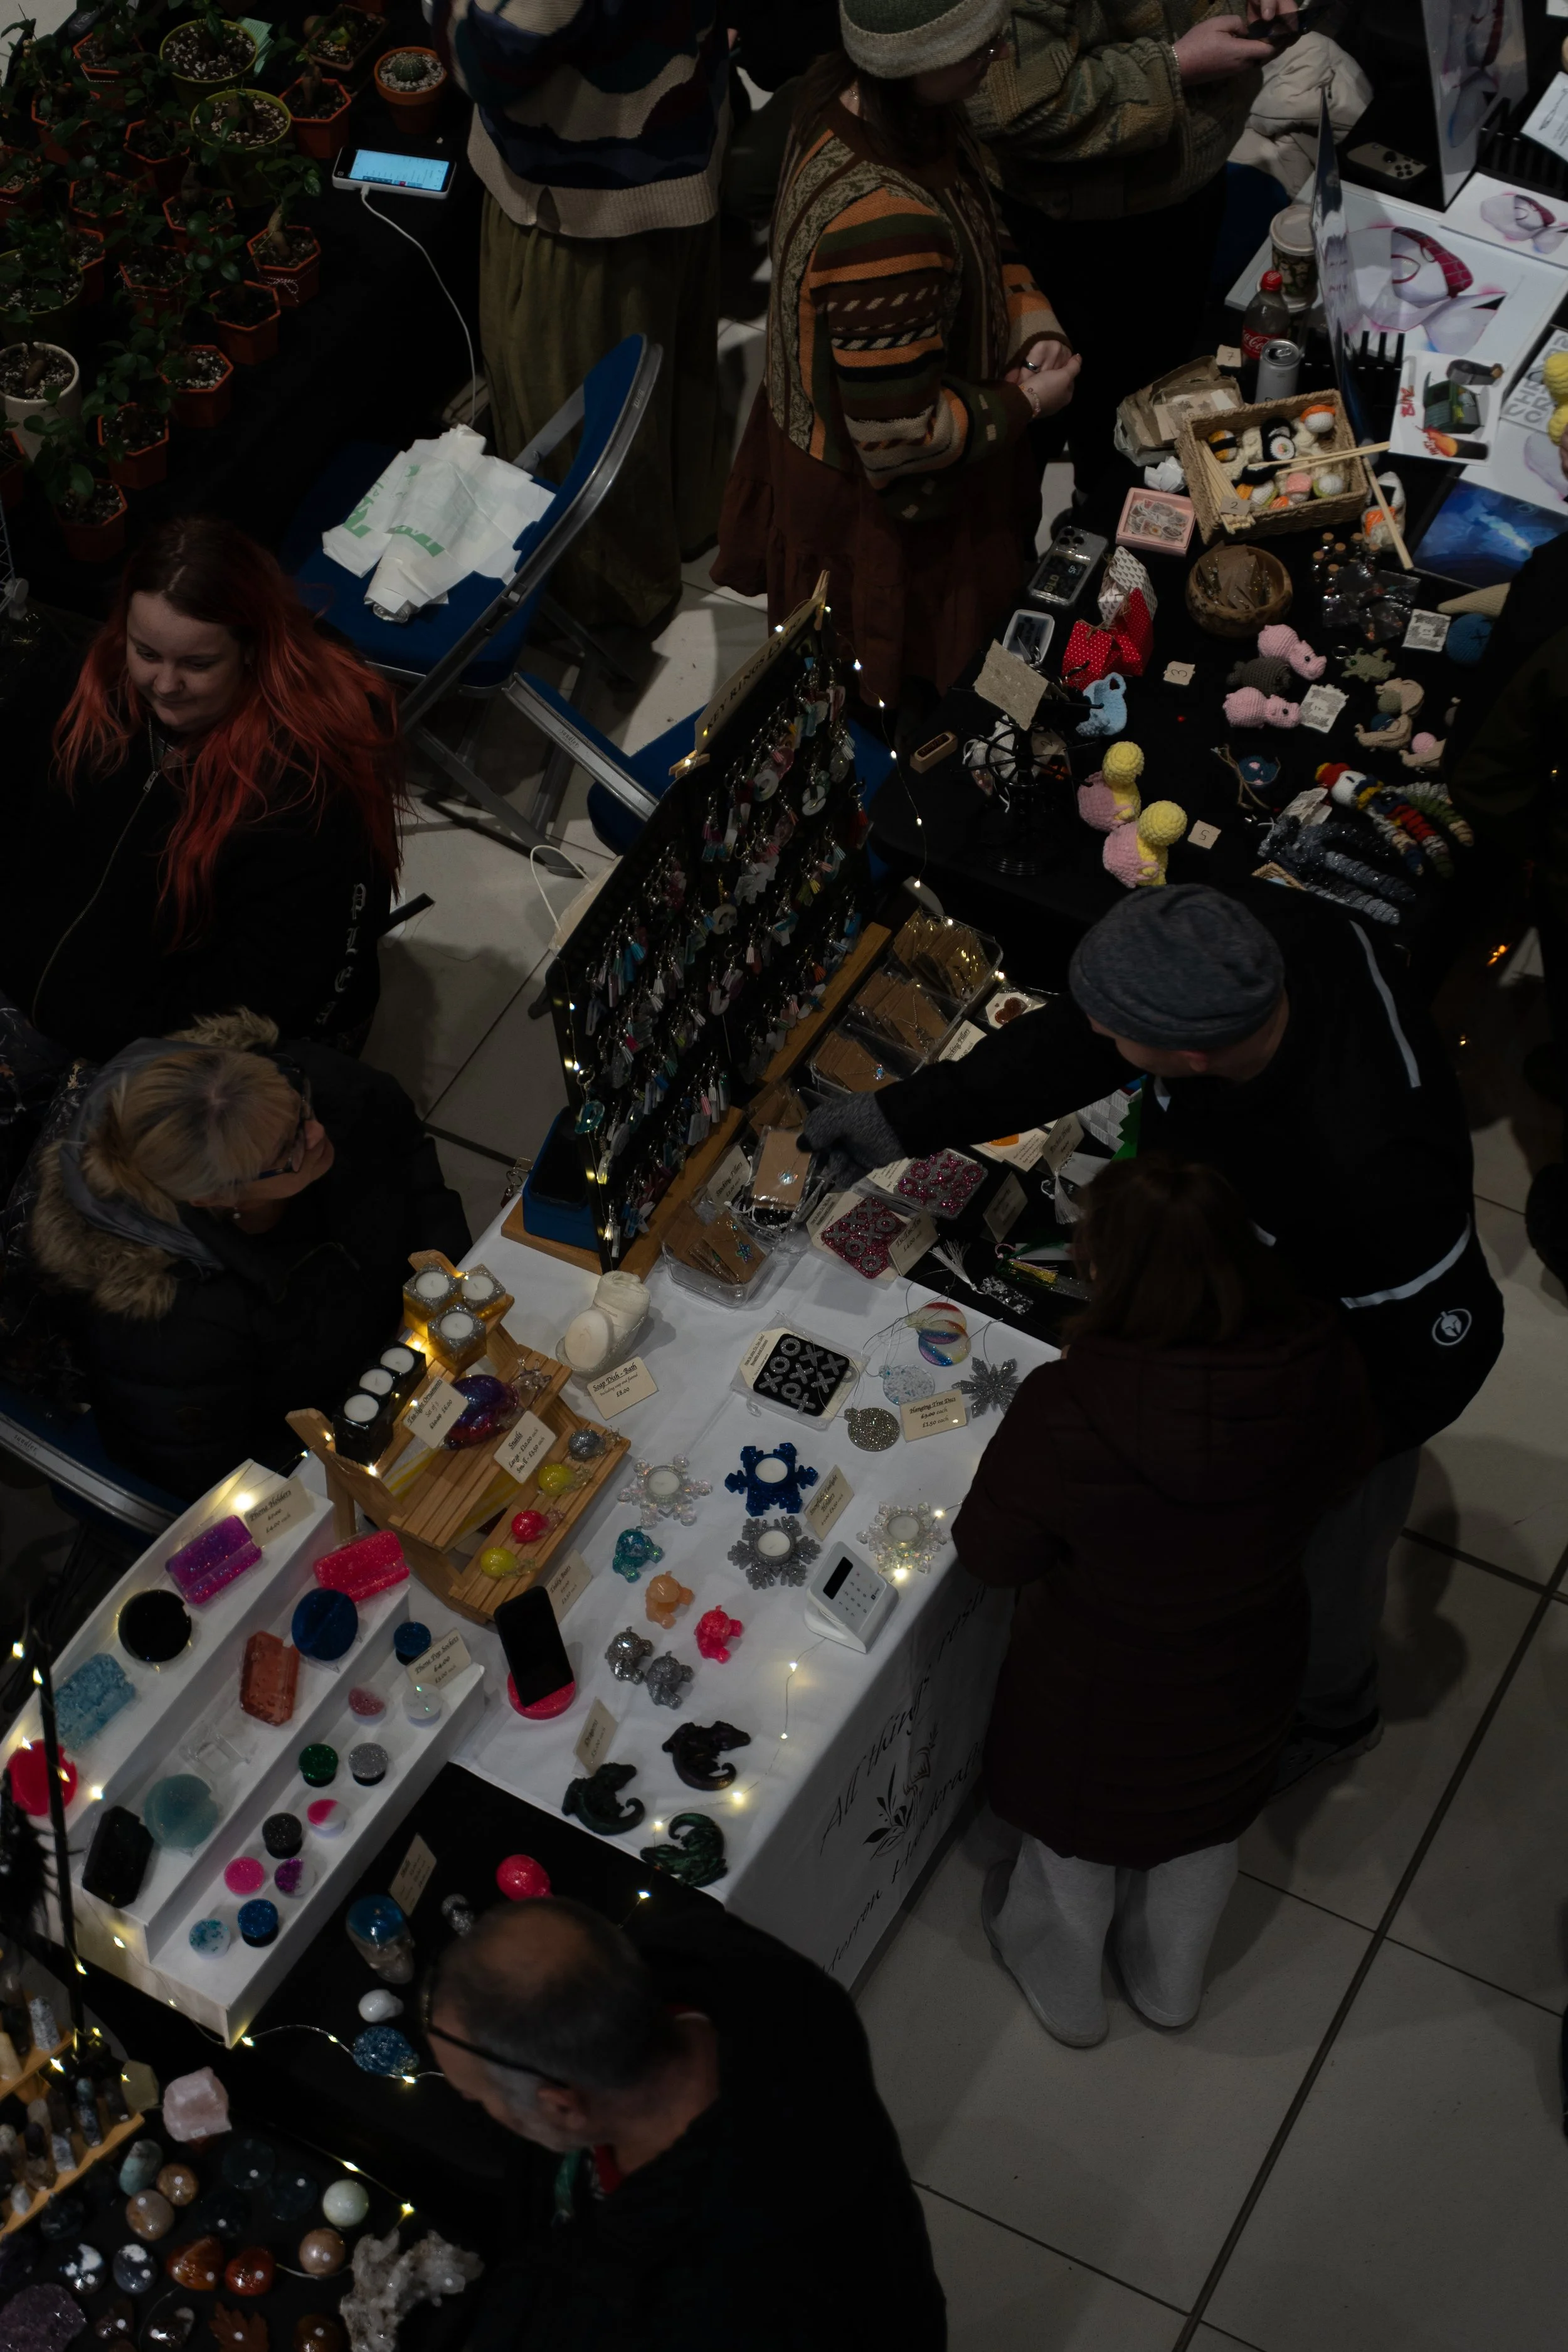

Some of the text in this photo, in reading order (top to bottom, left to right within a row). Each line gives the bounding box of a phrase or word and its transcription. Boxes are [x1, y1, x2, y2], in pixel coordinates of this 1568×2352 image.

[1230, 501, 1239, 509] 2
[729, 654, 766, 700] RINGS
[314, 881, 368, 1026] PLEA
[958, 1029, 971, 1044] Fillers
[716, 1162, 743, 1197] Stocking Fillers
[593, 1381, 607, 1392] Soap
[606, 1372, 620, 1385] Dish
[623, 1362, 637, 1375] Bath
[616, 1387, 630, 1397] £8.00
[909, 1406, 931, 1414] Hanging
[931, 1399, 943, 1407] Tree
[936, 1406, 948, 1414] each
[923, 1416, 949, 1428] £1.50 each
[14, 1434, 37, 1451] sandler
[508, 1431, 522, 1449] Snails
[509, 1455, 520, 1468] Large
[521, 1436, 532, 1452] £10.00
[516, 1458, 528, 1473] Small
[250, 1490, 292, 1522] Phone Holders
[415, 1635, 459, 1675] Phone Pop Sockets
[820, 1755, 867, 1857] All
[867, 1663, 931, 1776] things
